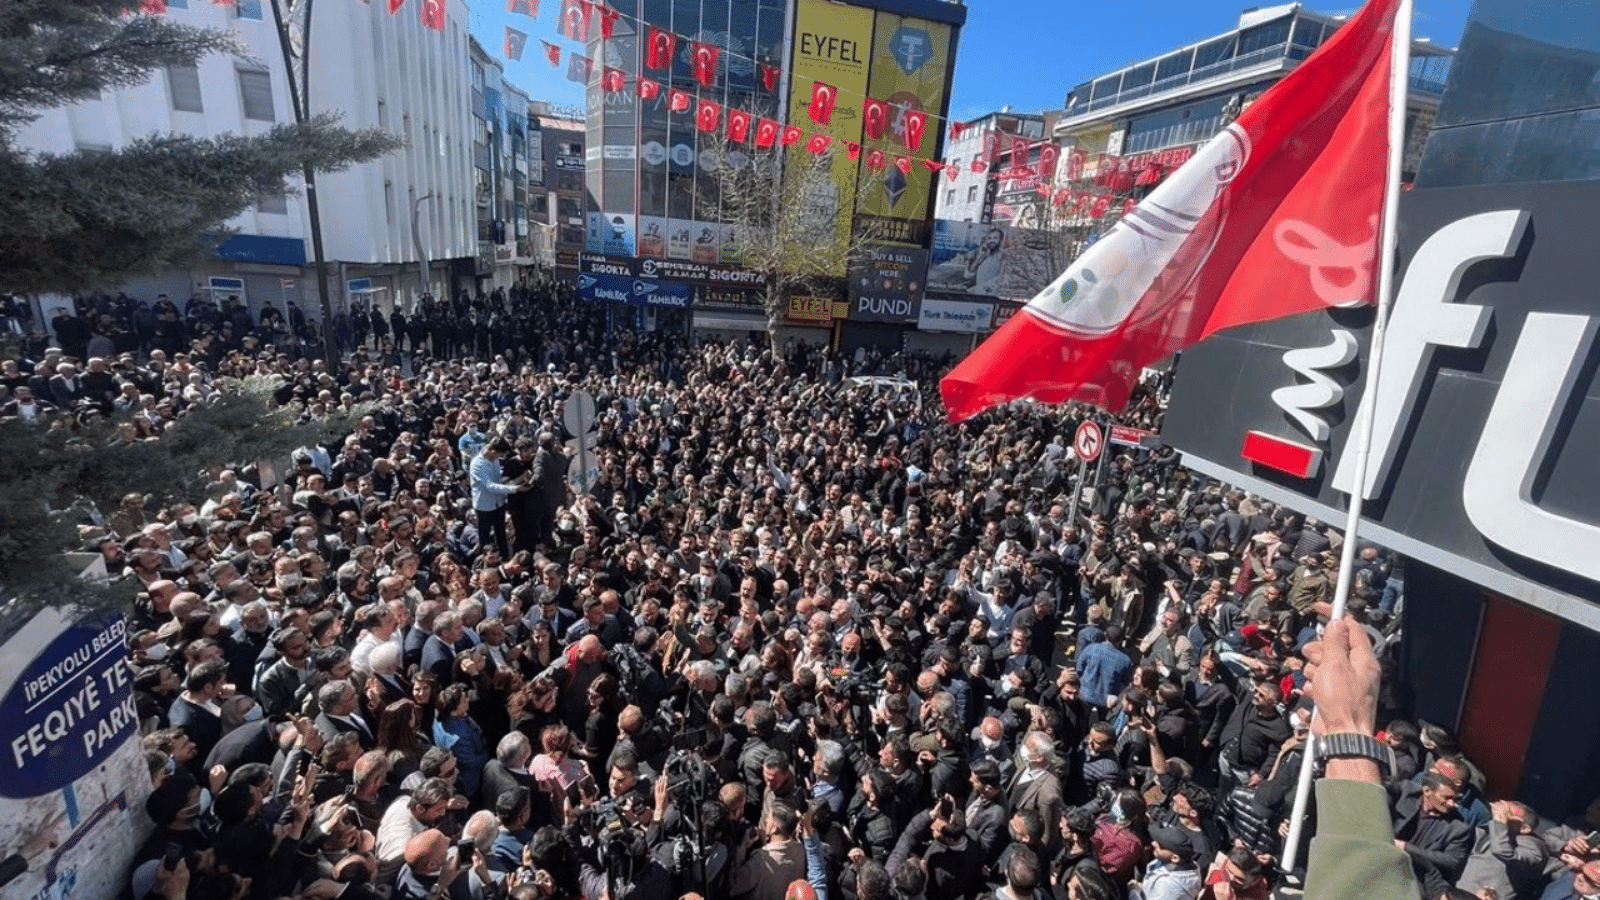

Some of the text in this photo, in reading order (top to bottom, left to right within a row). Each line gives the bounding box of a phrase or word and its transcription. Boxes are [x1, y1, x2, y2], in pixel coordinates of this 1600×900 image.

[801, 32, 862, 64] EYFEL
[1131, 146, 1192, 171] LUCIFER
[895, 254, 912, 263] SELL
[879, 269, 899, 278] HERE
[791, 297, 829, 313] EYFEL
[858, 296, 912, 316] PUNDI
[943, 311, 976, 321] Telekom
[23, 616, 127, 702] İPEKYOLU BELED
[11, 654, 128, 769] FEQIYÊ TE
[83, 693, 136, 759] PARK
